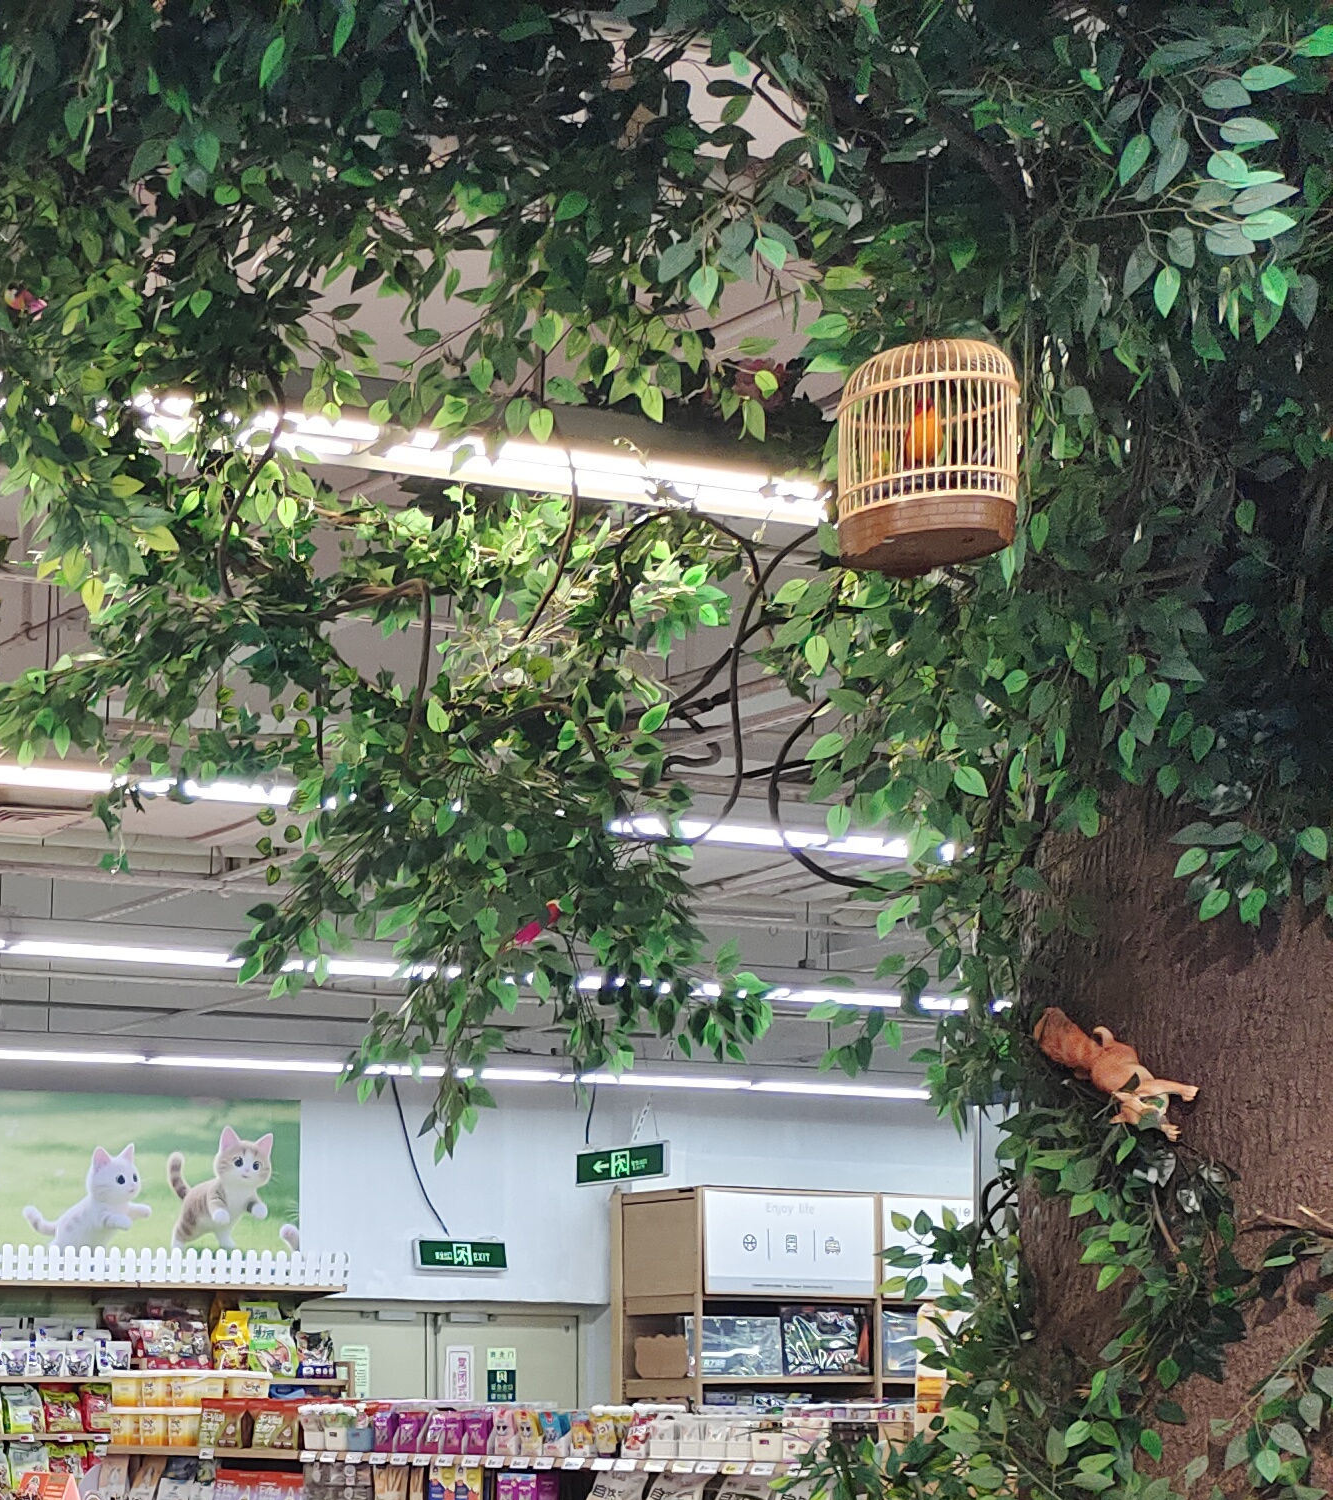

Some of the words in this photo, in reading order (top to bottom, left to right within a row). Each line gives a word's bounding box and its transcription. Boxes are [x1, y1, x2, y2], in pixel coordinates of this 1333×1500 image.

[765, 1202, 794, 1217] Enjoy
[799, 1202, 815, 1215] life
[473, 1252, 491, 1263] EXIT
